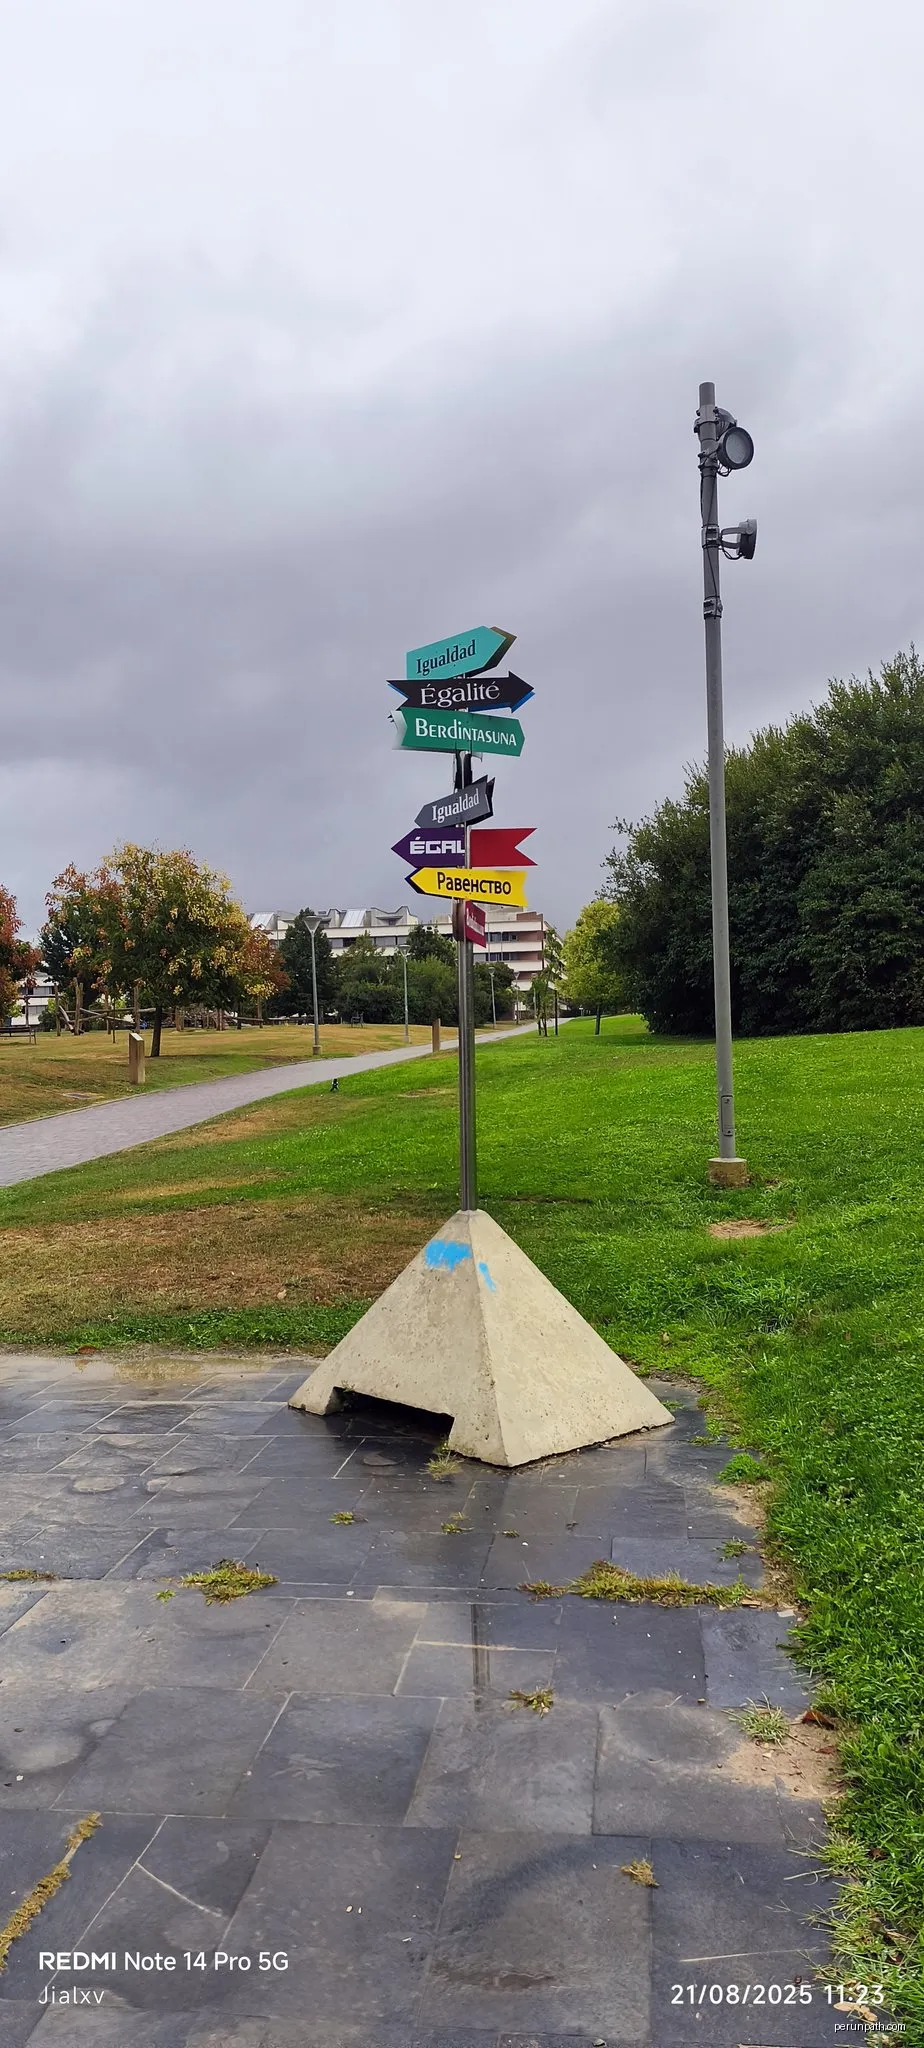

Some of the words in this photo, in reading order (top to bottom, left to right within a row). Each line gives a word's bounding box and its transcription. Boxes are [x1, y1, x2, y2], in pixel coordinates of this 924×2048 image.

[416, 639, 476, 676] Igualdad
[420, 681, 500, 708] Égalité
[431, 788, 480, 823] Igualdad
[437, 871, 512, 895] Равенство
